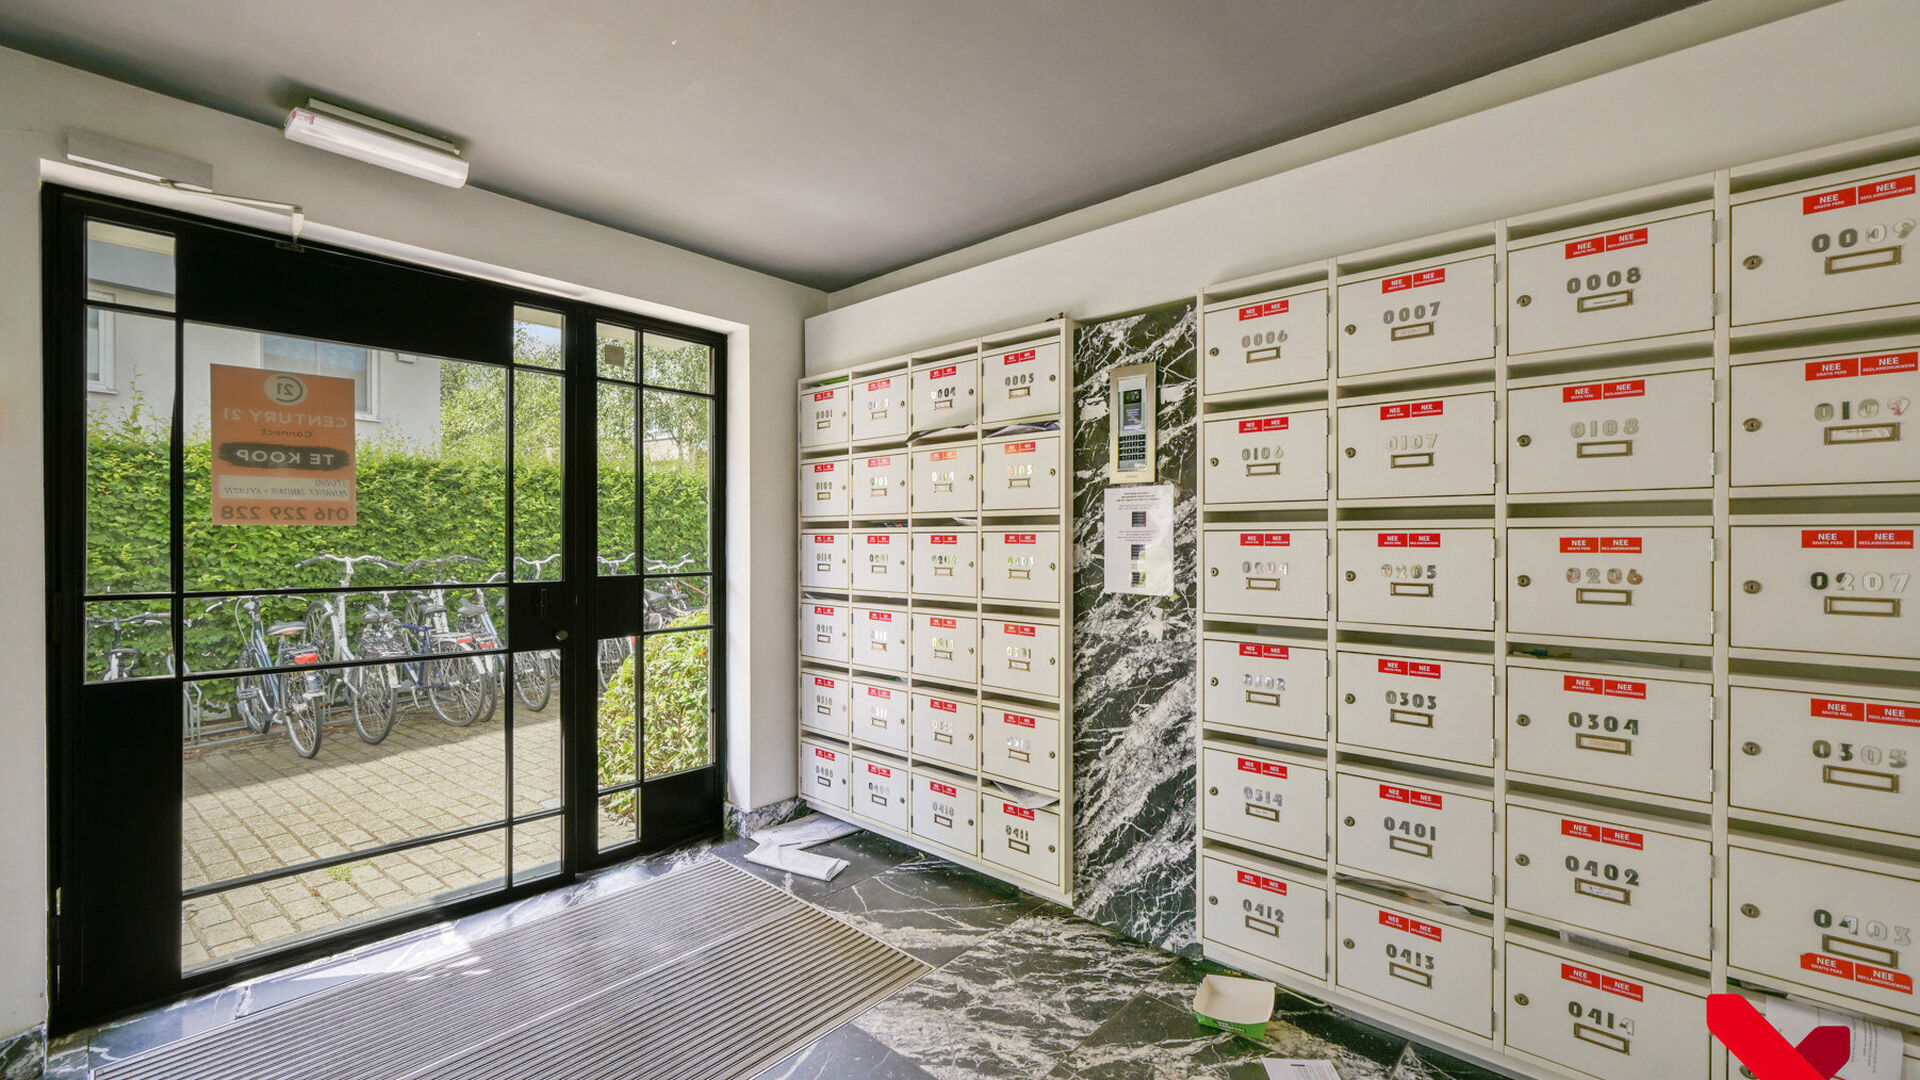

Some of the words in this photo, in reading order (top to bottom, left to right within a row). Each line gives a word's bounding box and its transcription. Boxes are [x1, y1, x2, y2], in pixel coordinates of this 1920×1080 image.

[1876, 182, 1897, 193] NEE
[1819, 193, 1839, 204] NEE
[1619, 233, 1634, 242] NEE
[1811, 218, 1917, 253] 0009
[1578, 242, 1592, 250] NEE
[1423, 272, 1435, 280] NEE
[1566, 266, 1642, 294] 0008
[1382, 301, 1441, 324] 0007
[1241, 330, 1288, 348] 0006
[1821, 363, 1841, 372] NEE
[1878, 357, 1899, 366] NEE
[1004, 372, 1034, 386] 0005
[1814, 396, 1911, 422] 0109
[1570, 418, 1640, 438] 0108
[1386, 433, 1439, 451] 0107
[1242, 446, 1284, 461] 0106
[1566, 567, 1644, 586] 0206
[1810, 571, 1911, 592] 0207
[1617, 683, 1632, 691] NEE
[1385, 690, 1438, 710] 0303
[1827, 703, 1847, 712] NEE
[1884, 708, 1905, 717] NEE
[1568, 711, 1640, 736] 0304
[1812, 740, 1908, 768] 0305
[1243, 786, 1284, 807] 0314
[1389, 788, 1400, 796] NEE
[1420, 794, 1432, 802] NEE
[1005, 824, 1030, 842] 0411
[1383, 816, 1437, 842] 0401
[1573, 824, 1588, 833] NEE
[1614, 832, 1630, 841] NEE
[1565, 855, 1640, 887] 0402
[1242, 898, 1285, 923] 0412
[1388, 915, 1399, 923] NEE
[1420, 924, 1432, 933] NEE
[1813, 908, 1912, 946] 0403
[1386, 943, 1435, 970] 0413
[1816, 956, 1838, 968] NEE
[1573, 969, 1588, 979] NEE
[1872, 970, 1895, 982] NEE
[1614, 981, 1630, 991] NEE
